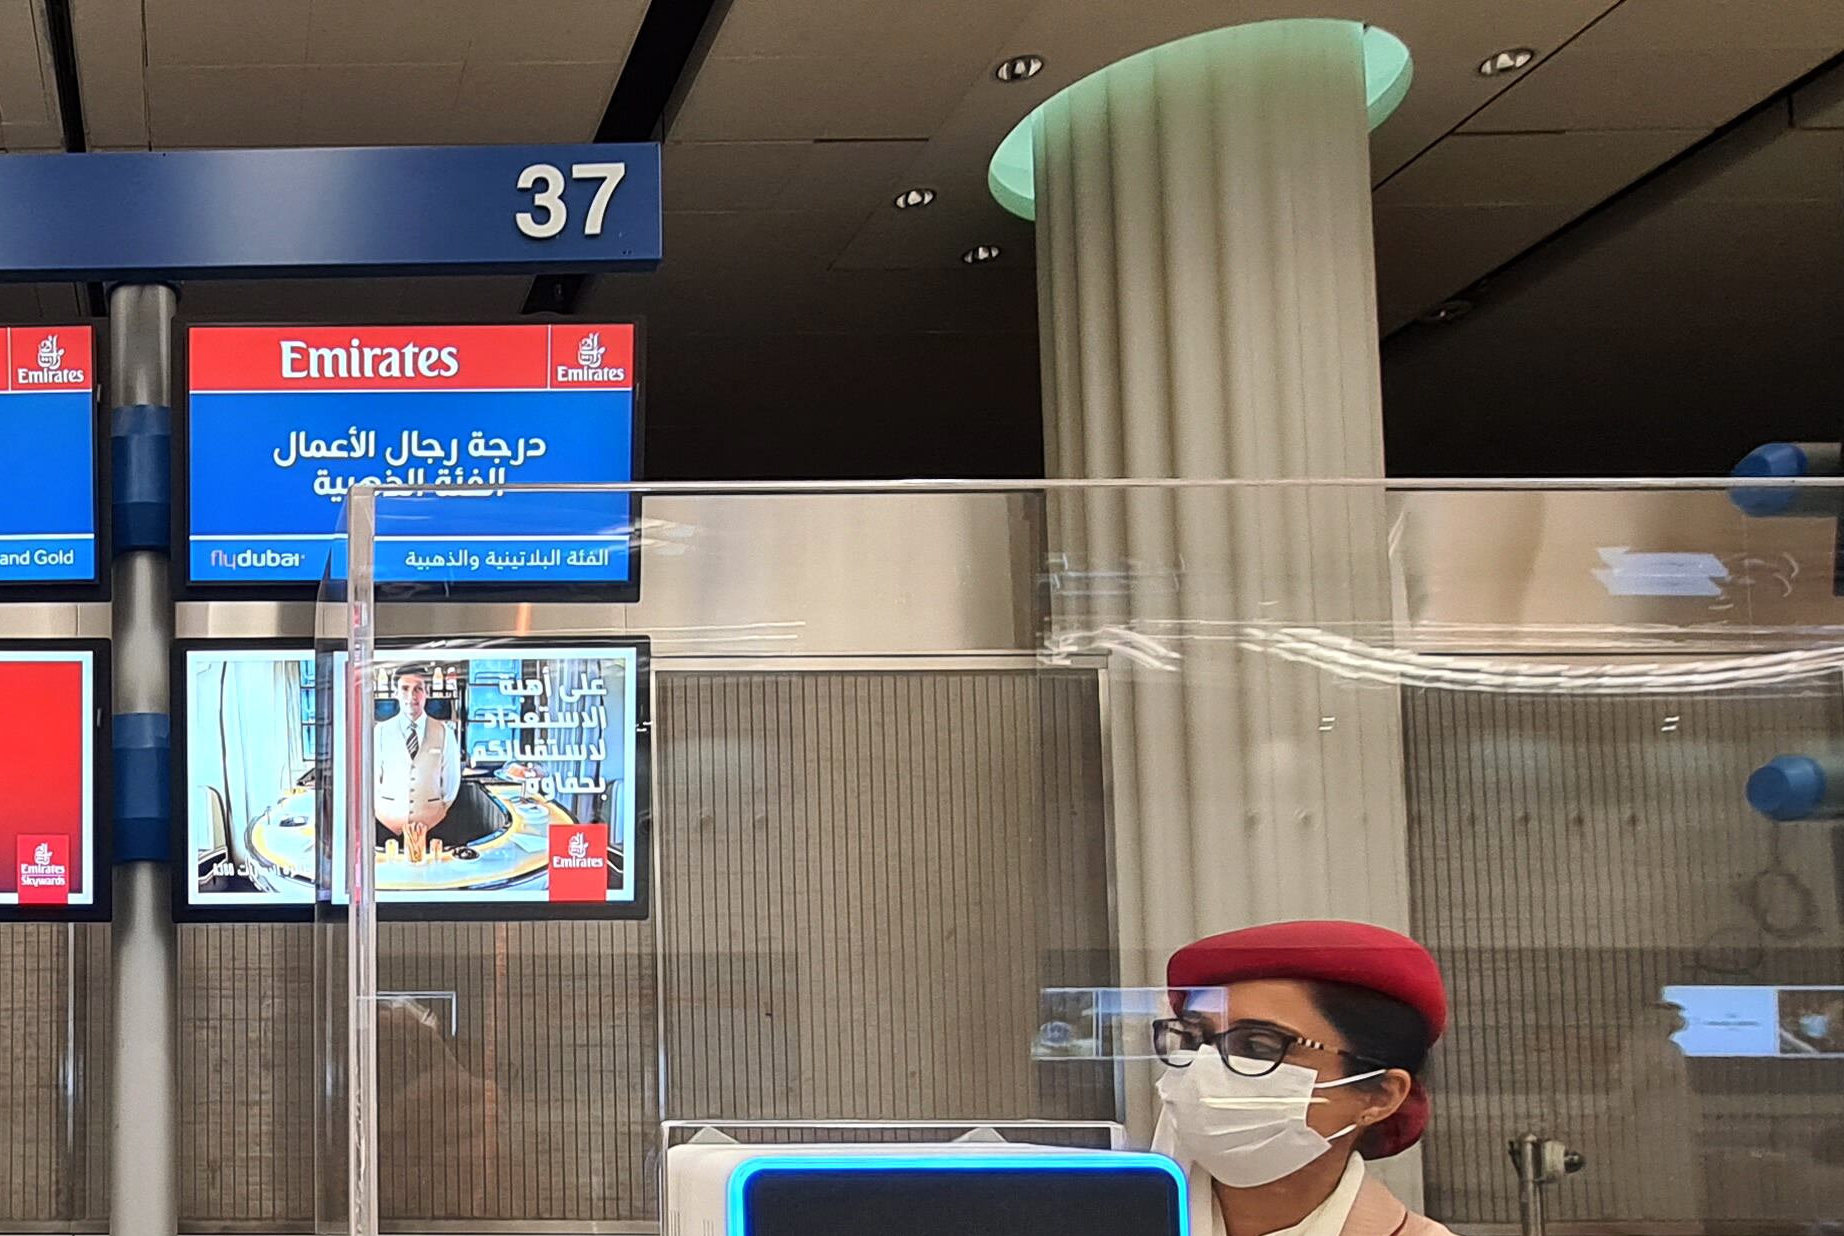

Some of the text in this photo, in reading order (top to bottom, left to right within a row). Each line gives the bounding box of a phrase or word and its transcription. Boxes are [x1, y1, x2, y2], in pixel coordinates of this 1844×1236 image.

[516, 163, 626, 239] 37
[280, 338, 458, 379] Emirates
[18, 367, 84, 385] Emirates
[557, 366, 624, 382] Emirates
[274, 426, 547, 467] درجة رجال الأعمال
[0, 551, 30, 566] and
[34, 549, 74, 566] Gold
[211, 550, 300, 570] flydubai
[405, 549, 608, 570] الفئة البلاتينية والذهبية
[560, 675, 607, 703] على
[21, 863, 65, 875] Emirates
[553, 857, 603, 869] Emirates
